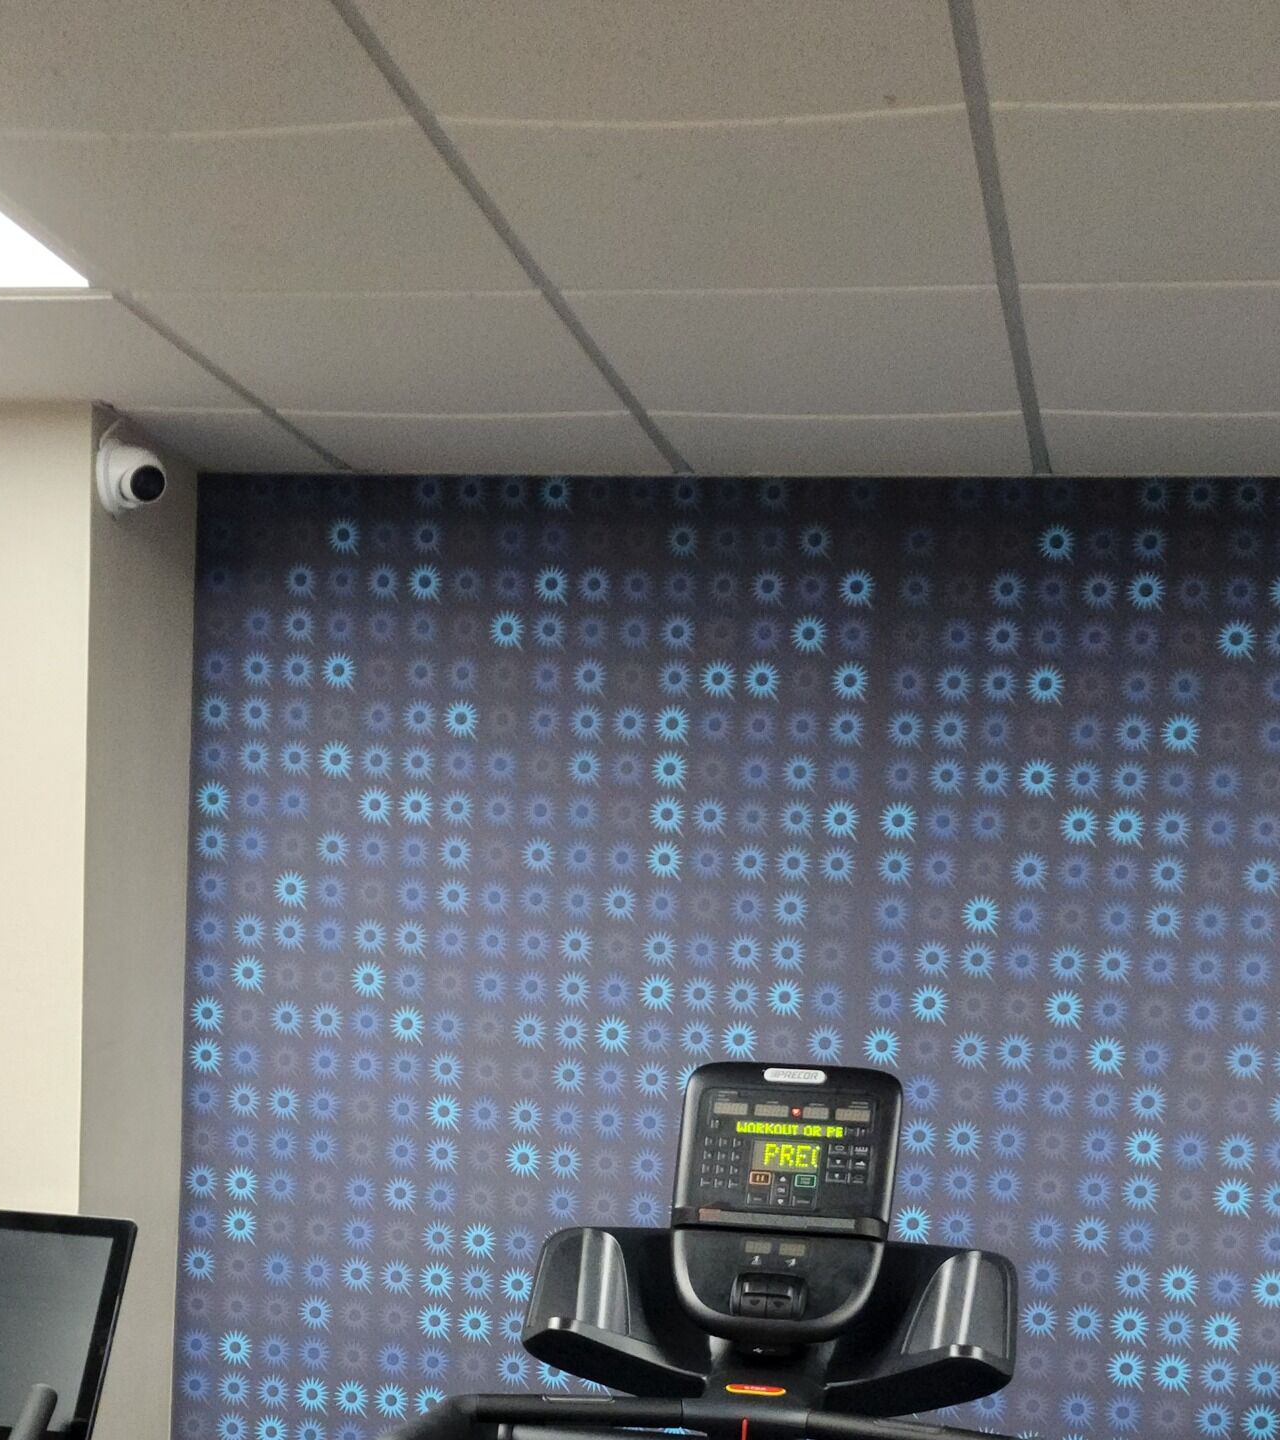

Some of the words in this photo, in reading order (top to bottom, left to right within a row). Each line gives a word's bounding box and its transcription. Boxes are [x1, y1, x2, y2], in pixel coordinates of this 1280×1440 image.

[774, 1070, 819, 1081] PRECOR
[736, 1121, 798, 1135] WORKOUT
[803, 1124, 822, 1137] OR
